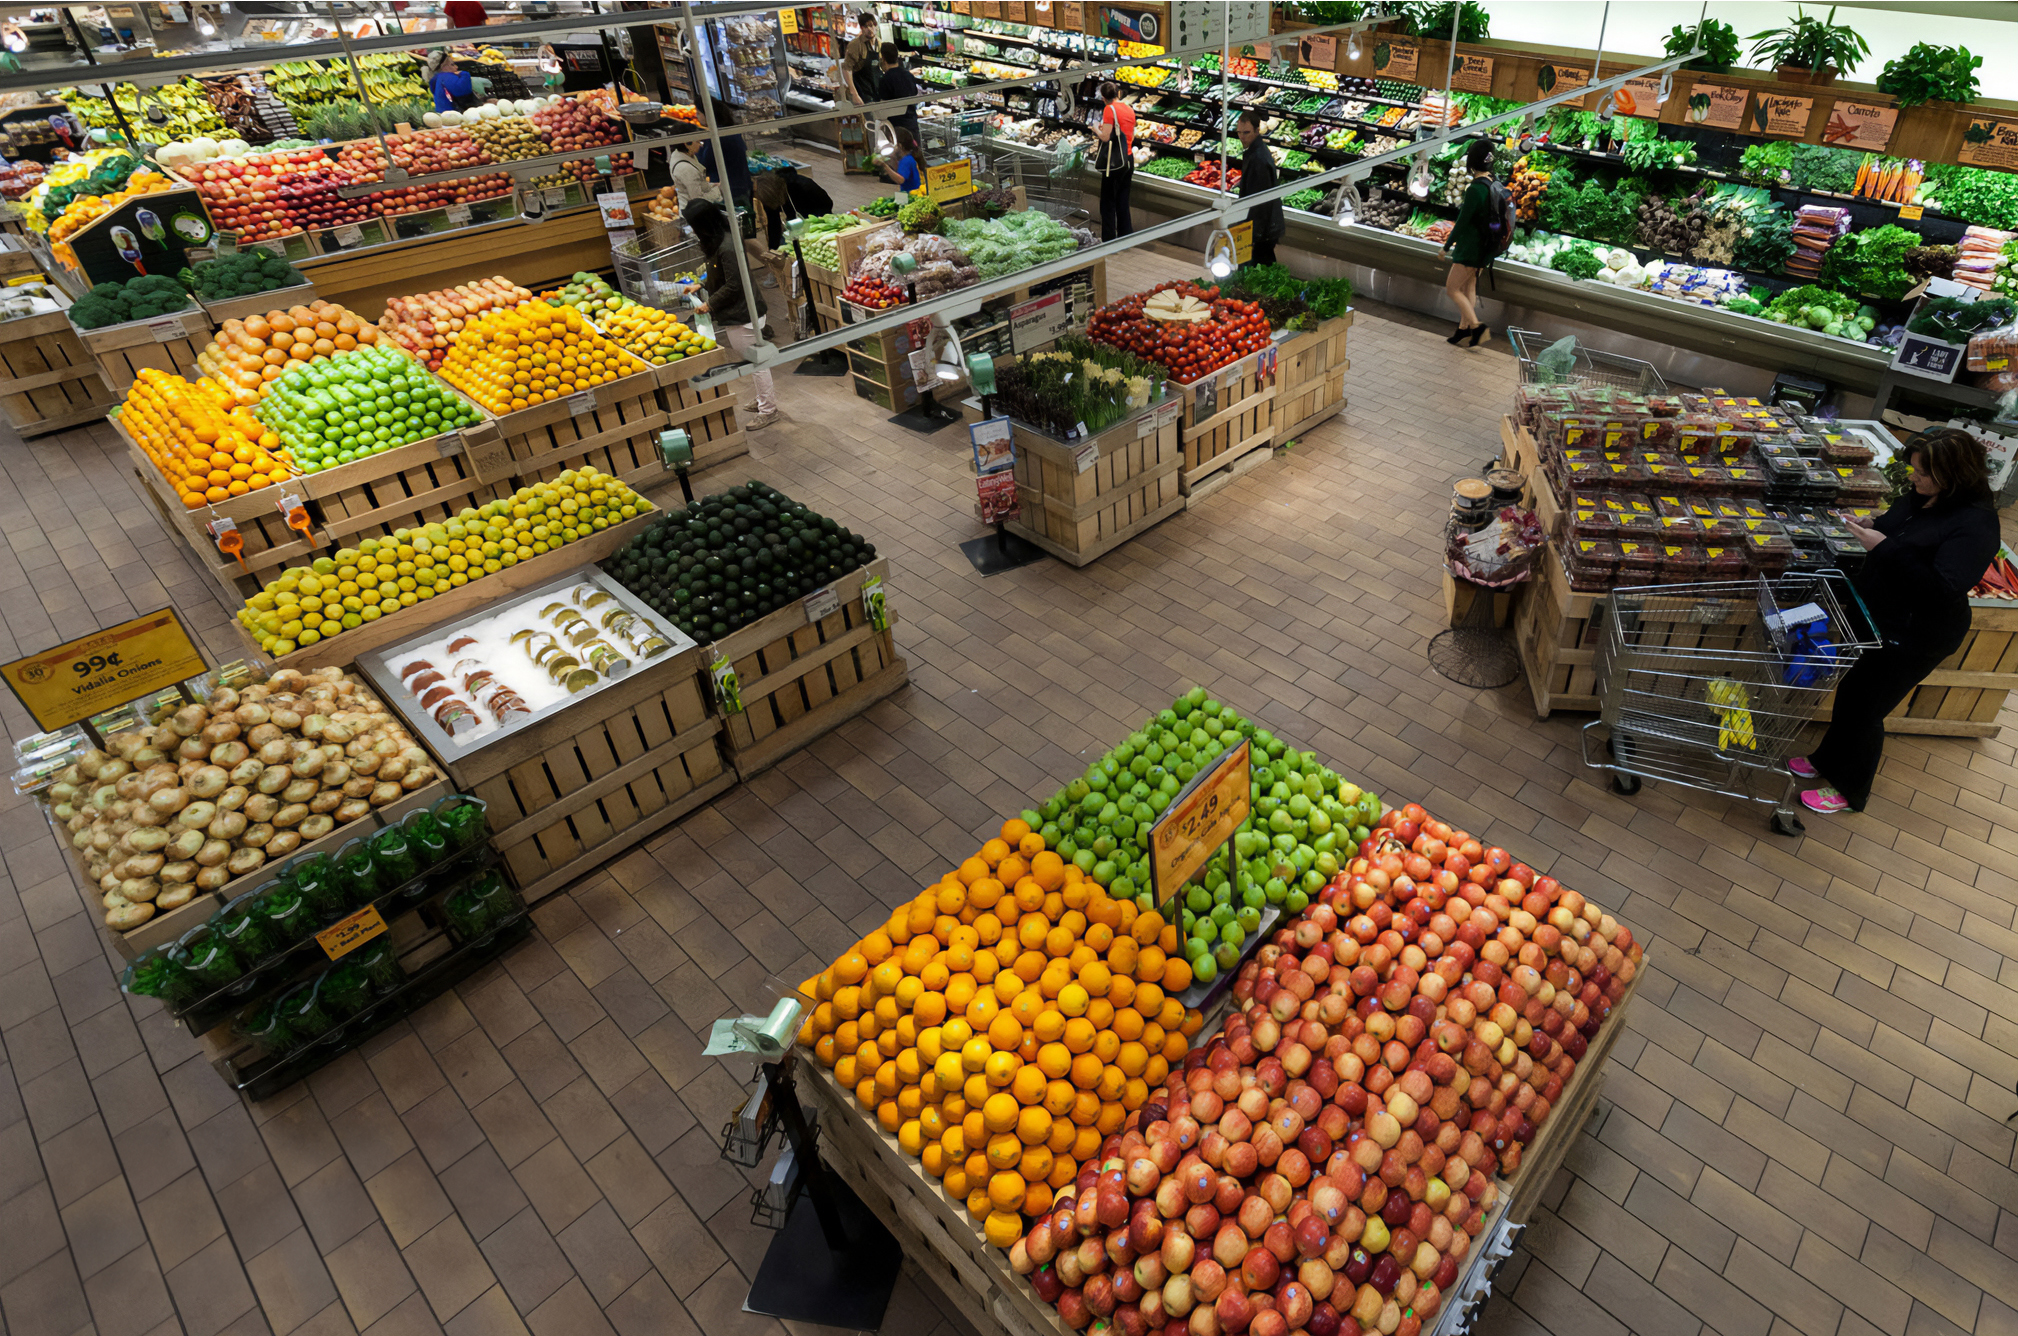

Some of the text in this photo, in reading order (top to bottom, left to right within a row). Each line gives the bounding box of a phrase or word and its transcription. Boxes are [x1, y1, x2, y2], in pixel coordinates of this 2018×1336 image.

[1013, 312, 1047, 330] Asparagus
[71, 657, 163, 695] Vidalia Onions
[72, 651, 124, 679] 99¢
[1181, 794, 1219, 837] $2.49
